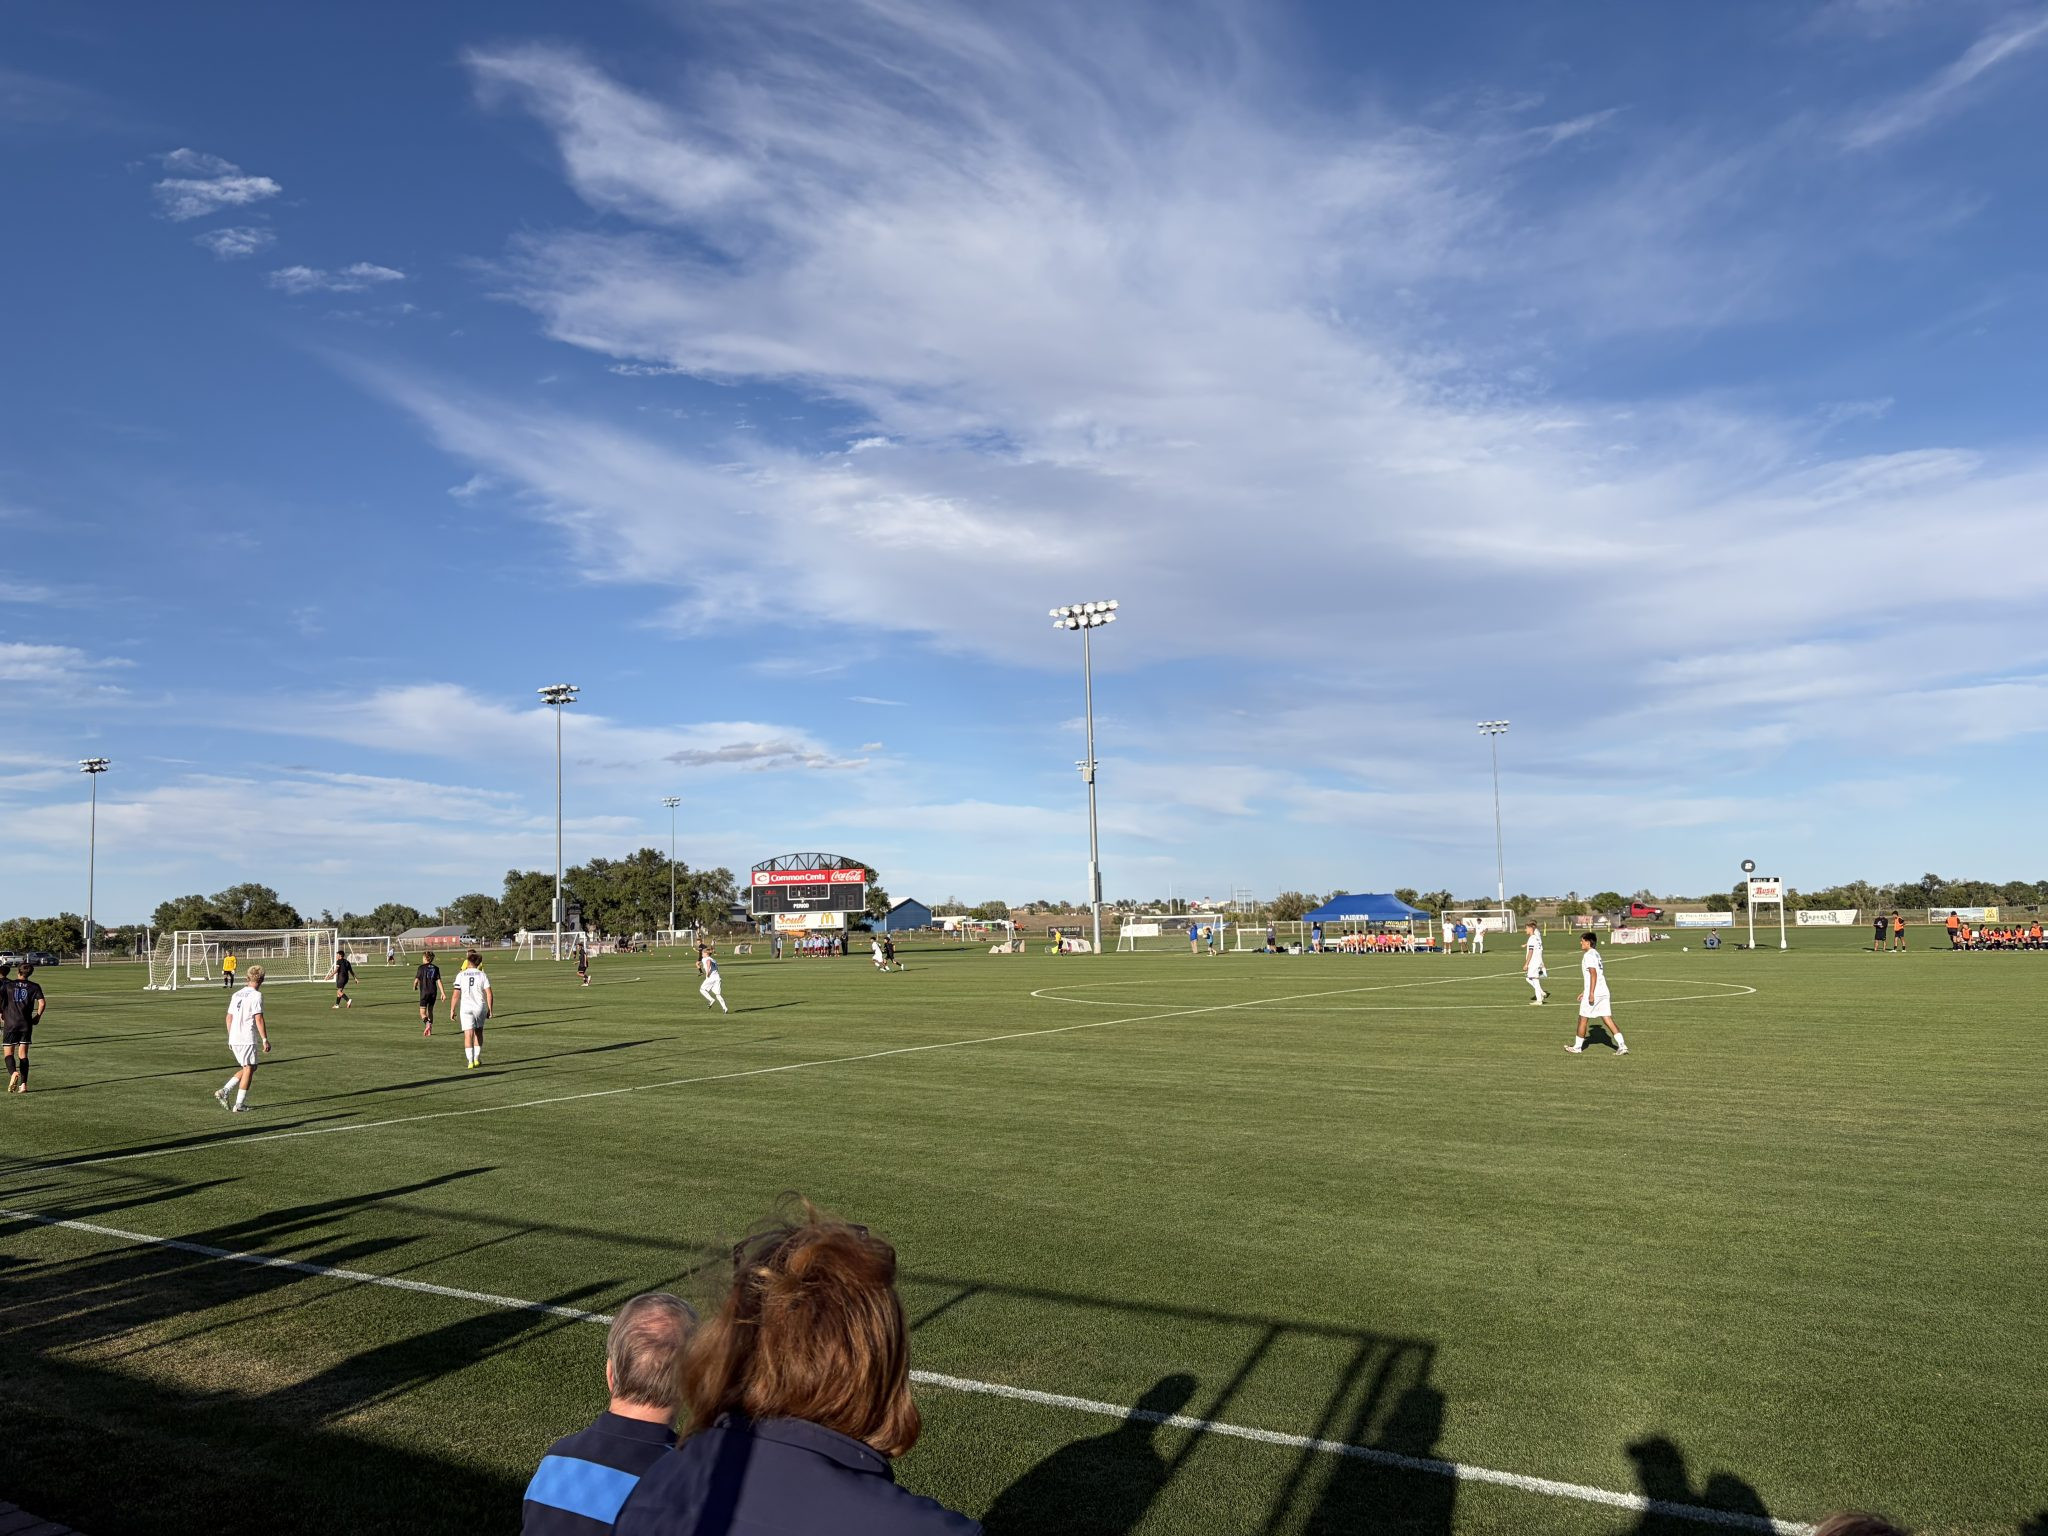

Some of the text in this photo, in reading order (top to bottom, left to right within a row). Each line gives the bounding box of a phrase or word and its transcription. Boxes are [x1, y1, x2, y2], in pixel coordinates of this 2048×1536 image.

[1745, 862, 1752, 870] 2
[771, 873, 825, 882] Common Cents
[777, 914, 807, 924] Scull
[468, 976, 475, 987] 8
[14, 987, 28, 1002] 19
[236, 999, 243, 1012] 4
